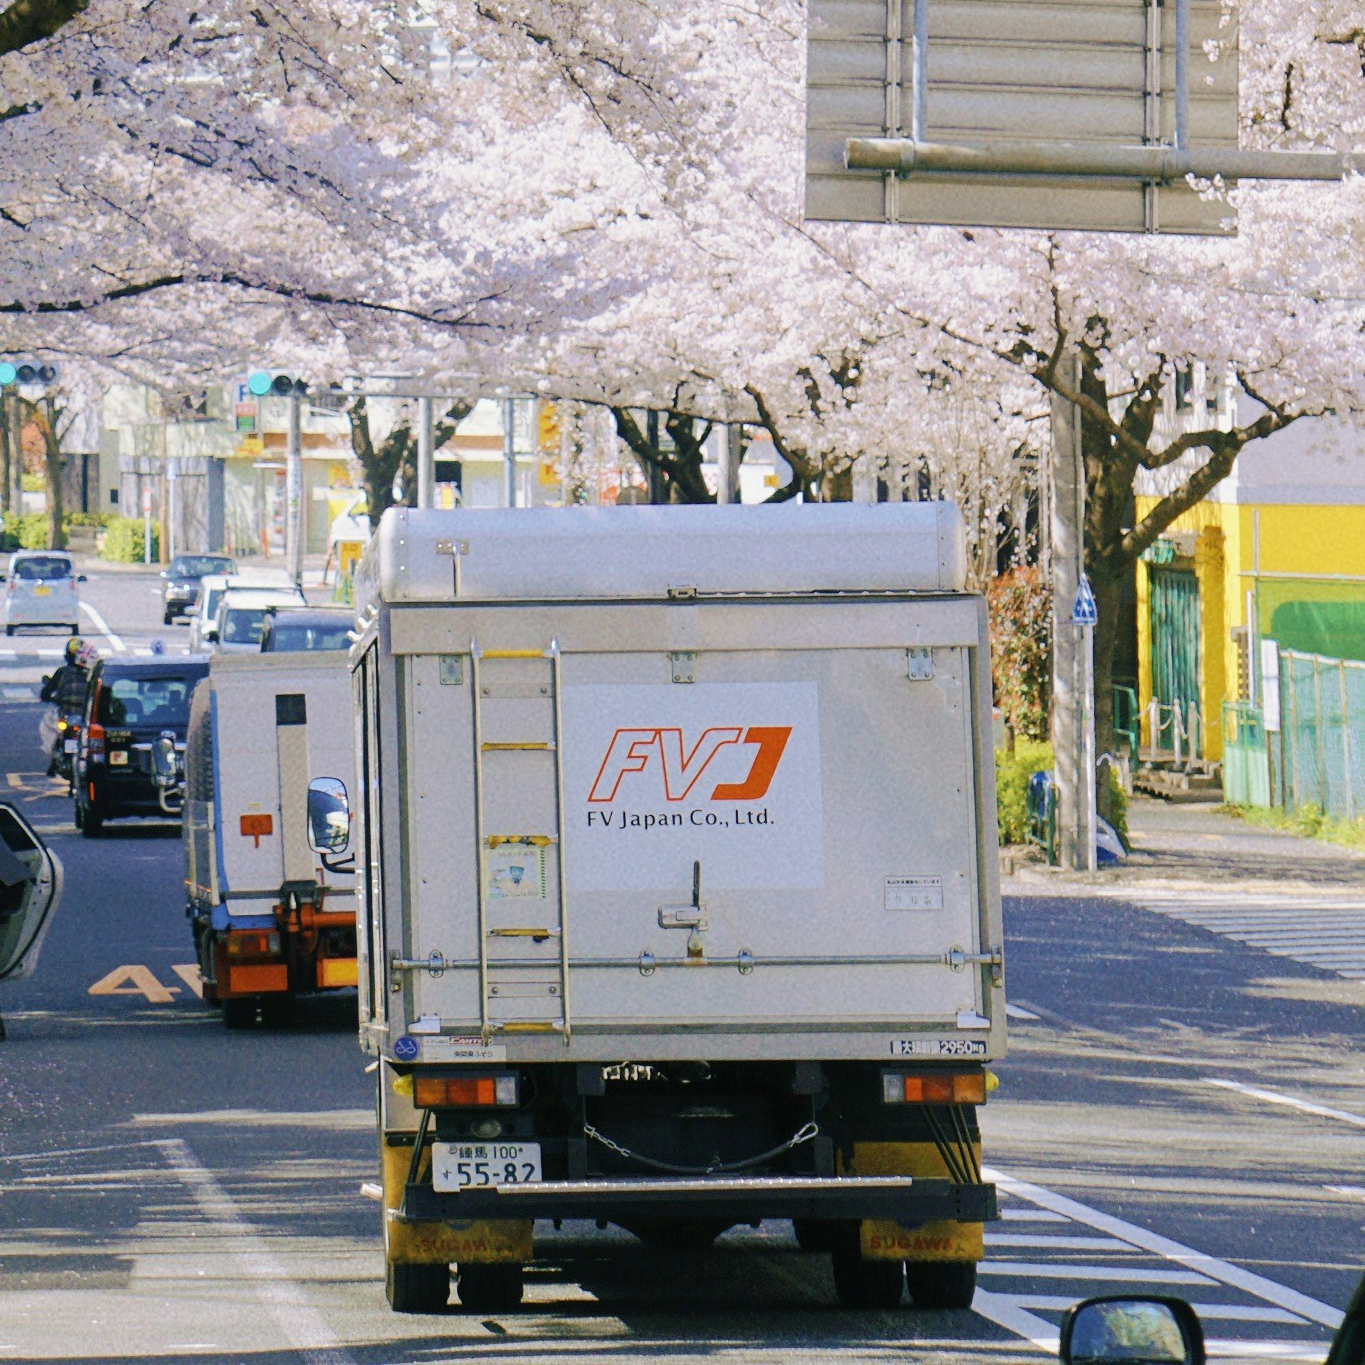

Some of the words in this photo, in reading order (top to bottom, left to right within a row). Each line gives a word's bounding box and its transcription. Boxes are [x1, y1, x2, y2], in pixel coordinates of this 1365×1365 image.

[587, 725, 794, 802] FVJ
[587, 810, 614, 827] FV
[619, 810, 683, 829] Japan
[690, 809, 729, 828] Co.,
[735, 808, 775, 825] Ltd.
[459, 1146, 488, 1159] 練馬
[493, 1146, 518, 1159] 100
[457, 1162, 536, 1186] 55-82
